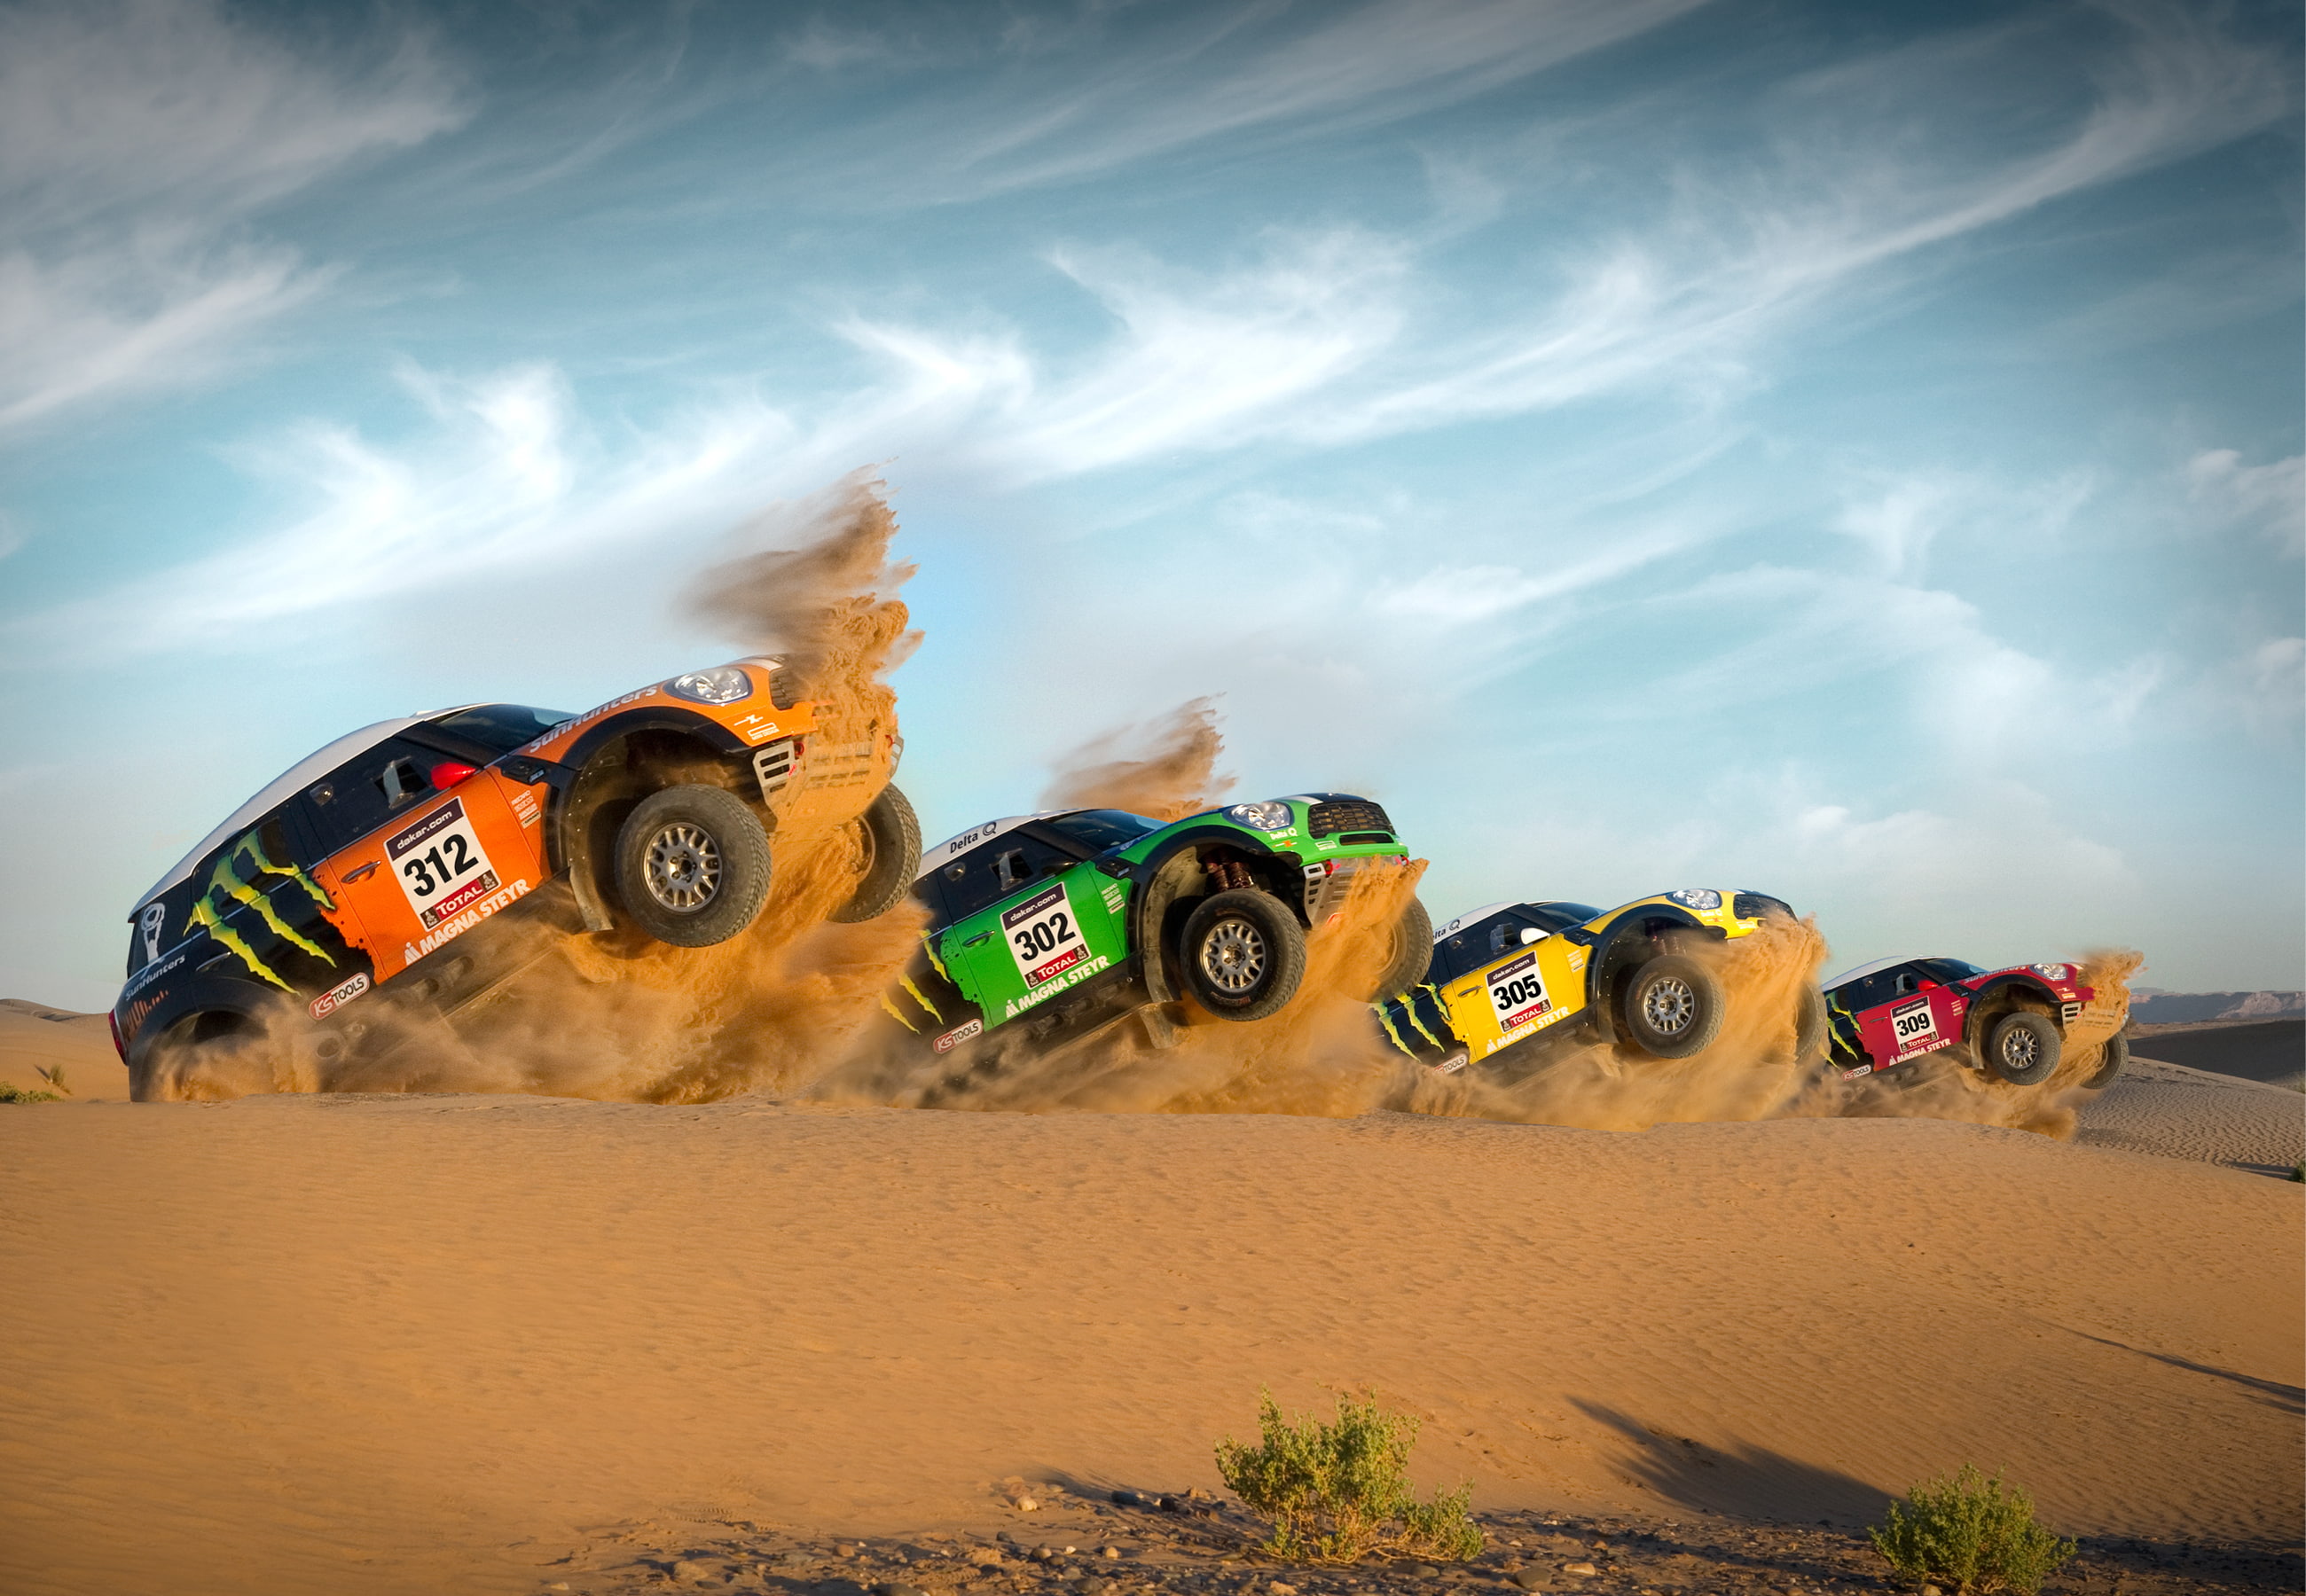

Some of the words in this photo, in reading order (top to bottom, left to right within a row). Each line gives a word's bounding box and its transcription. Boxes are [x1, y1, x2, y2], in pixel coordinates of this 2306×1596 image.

[396, 810, 453, 849] dakar.com
[950, 833, 978, 854] Delta
[982, 821, 997, 836] Q
[404, 833, 479, 897] 312
[436, 886, 483, 916] TOTAL
[1009, 893, 1057, 922] dakar.com
[419, 911, 482, 956] MAGNA
[479, 879, 531, 917] STEYR
[1449, 919, 1461, 931] Q
[1014, 911, 1077, 961] 302
[1038, 956, 1076, 978] TOTAL
[1493, 958, 1530, 980] dakar.com
[1018, 977, 1070, 1011] MAGNA
[1067, 955, 1110, 984] STEYR
[1493, 974, 1541, 1010] 305
[1496, 1022, 1537, 1048] MAGNA
[1536, 1006, 1571, 1029] STEYR
[1510, 1007, 1541, 1025] TOTAL
[1896, 1012, 1930, 1037] 309
[1897, 1047, 1927, 1063] MAGNA
[1926, 1038, 1951, 1052] STEYR
[1907, 1037, 1931, 1047] TOTAL
